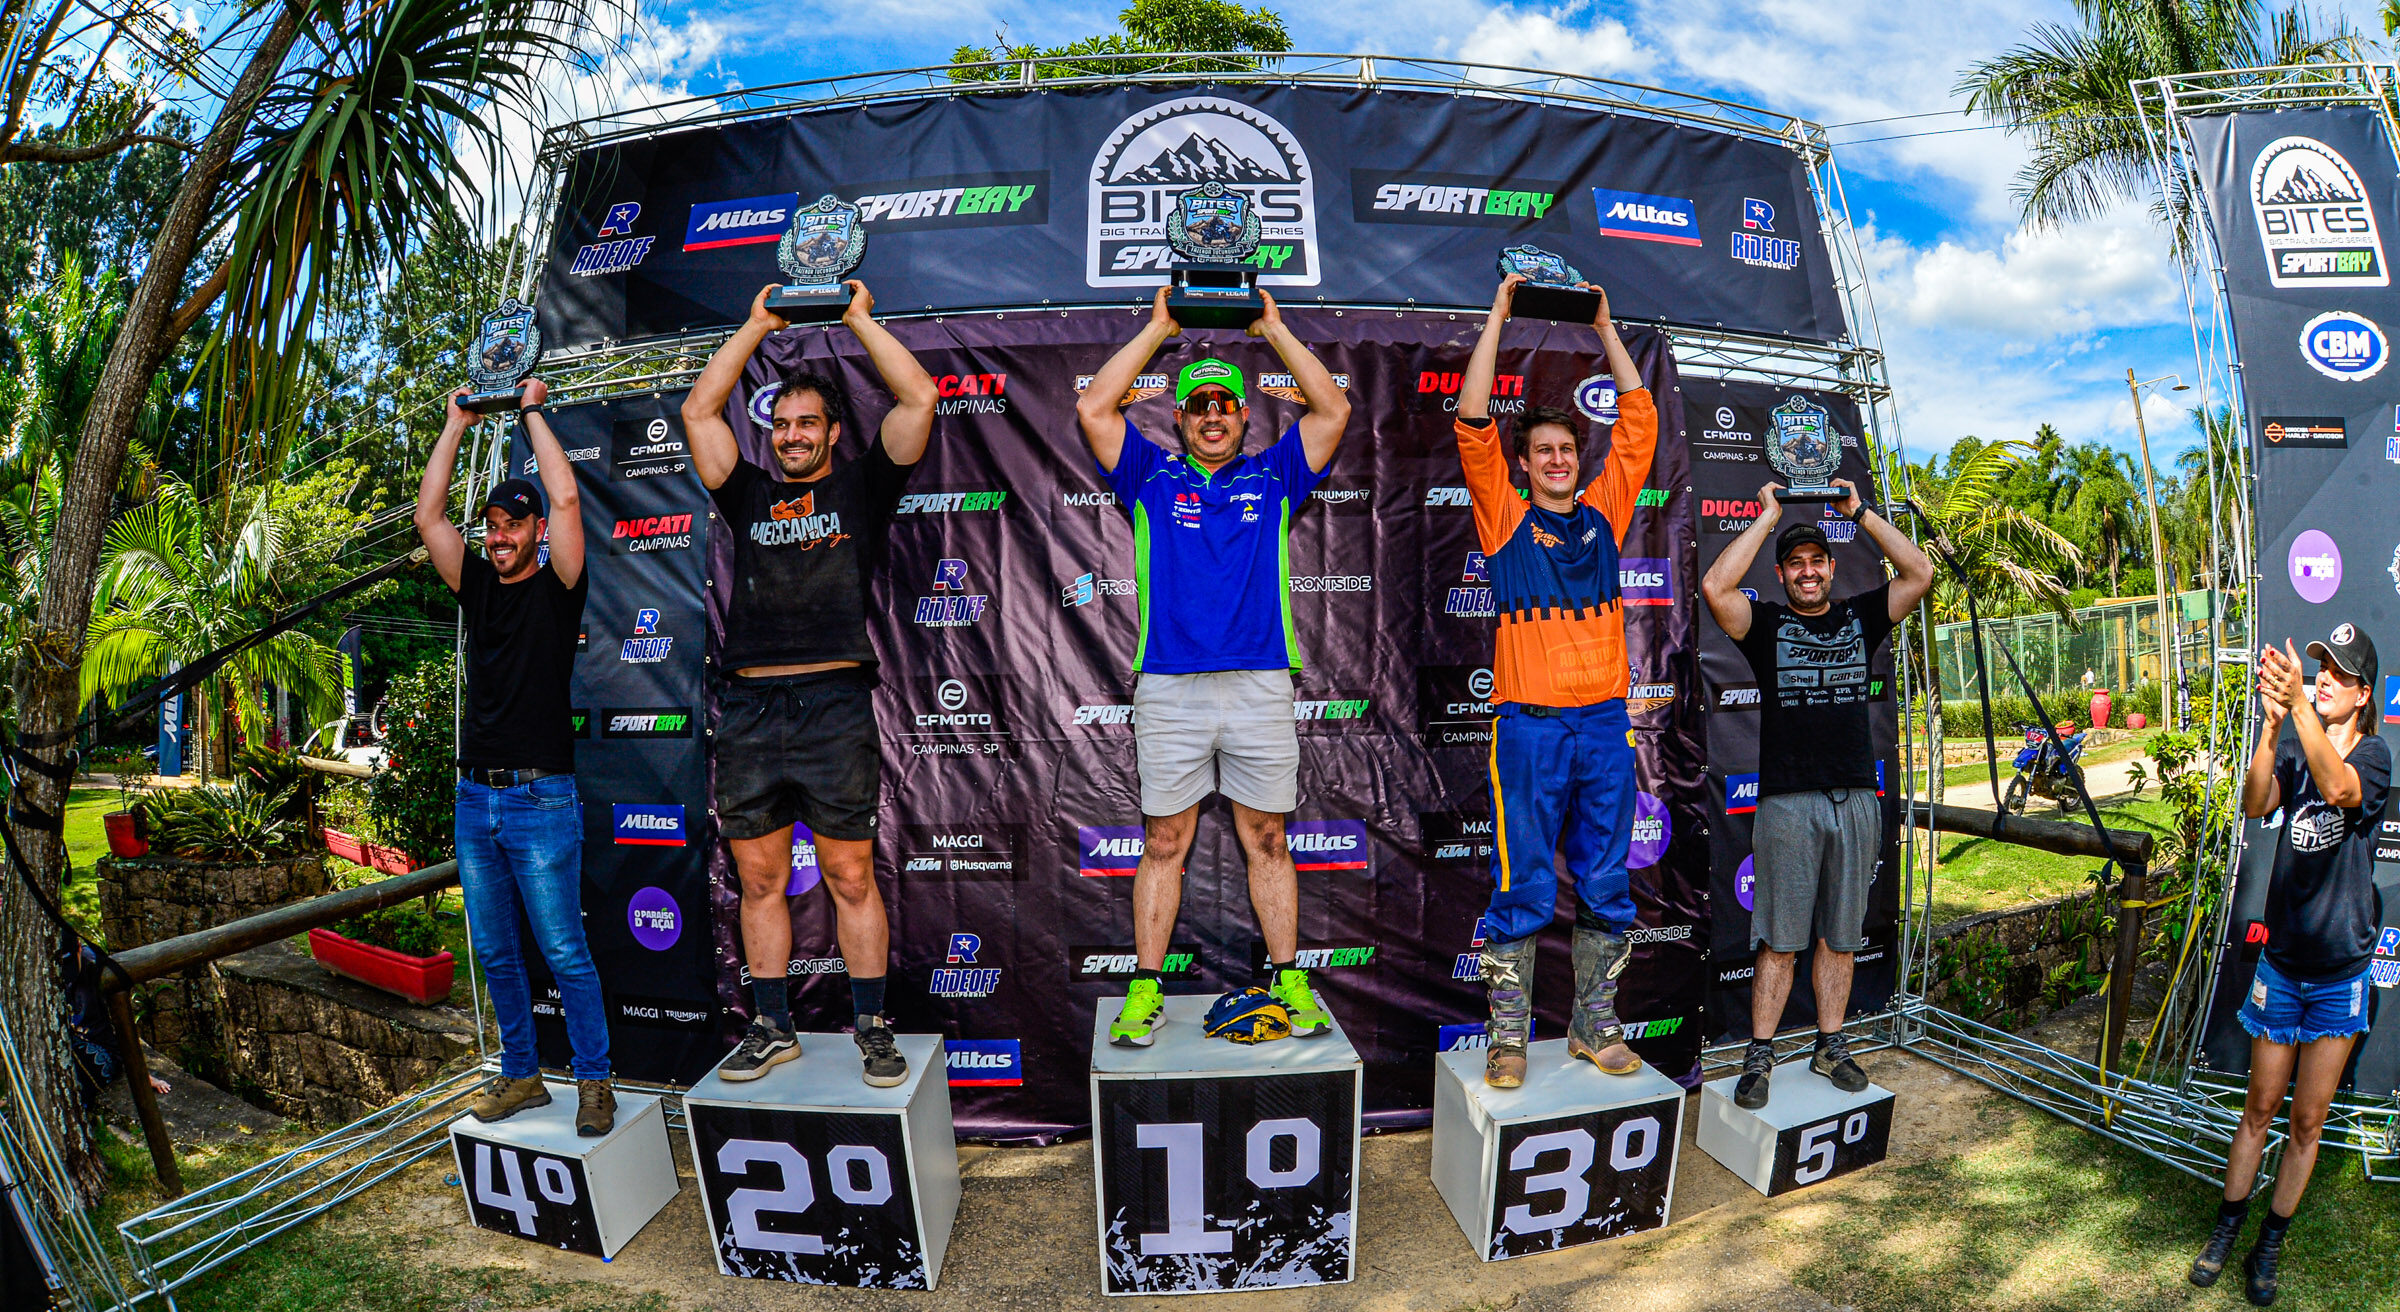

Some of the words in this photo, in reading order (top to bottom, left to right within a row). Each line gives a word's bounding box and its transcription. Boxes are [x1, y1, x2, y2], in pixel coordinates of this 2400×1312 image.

[853, 184, 1036, 223] SPORTBAY
[1191, 200, 1236, 210] BITES
[1373, 183, 1554, 219] SPORTBAY
[695, 207, 786, 233] Mitas
[804, 214, 847, 227] BITES
[1606, 200, 1690, 228] Mitas
[2262, 207, 2370, 235] BITES
[1100, 228, 1125, 236] BIG
[1129, 228, 1167, 236] TRAI
[1261, 228, 1304, 236] ERIES
[2269, 238, 2283, 246] BIG
[2310, 237, 2344, 245] ENDURO
[2346, 236, 2374, 244] SERIES
[1111, 245, 1293, 271] SPOAY
[2281, 251, 2372, 274] SPORTBAY
[580, 264, 632, 278] CALIFORNIA
[490, 317, 525, 334] BITES
[2314, 330, 2371, 358] CBM
[934, 373, 1007, 397] CATI
[1133, 375, 1167, 388] OTOS
[1418, 371, 1524, 397] DUTI
[1443, 397, 1525, 414] CAINAS
[1585, 387, 1618, 408] CB
[934, 398, 1006, 416] AMPINAS
[1781, 415, 1818, 427] BITES
[1703, 430, 1752, 441] CFMOTO
[564, 446, 601, 461] NTSIDE
[630, 441, 683, 456] CFMOTO
[1703, 451, 1743, 460] CAMPINAS
[1748, 453, 1758, 461] SP
[625, 464, 668, 478] CAMPINAS
[674, 463, 686, 473] SP
[897, 491, 1007, 514] SPORTBAY
[1063, 492, 1116, 506] MAGGI
[1311, 490, 1359, 504] TRIUMPH
[1702, 499, 1763, 518] DUCAT
[612, 514, 693, 539] DUCATI
[751, 512, 840, 546] MECCANICA
[628, 535, 691, 552] CAMPINAS
[801, 529, 852, 551] Gaage
[1620, 570, 1664, 587] itas
[925, 620, 972, 628] CALIFORNIA
[1559, 643, 1619, 669] ADVENTU
[1788, 641, 1860, 663] SPORTBAY
[1790, 675, 1813, 683] Shell
[1633, 684, 1674, 699] MOTOS
[1720, 688, 1761, 705] SPORT
[163, 660, 181, 743] Mits
[1293, 699, 1369, 720] RTBAY
[1447, 702, 1494, 715] CFMO
[609, 715, 687, 731] SPORTBAY
[915, 713, 991, 726] CFMOTO
[1072, 704, 1136, 725] SPORT
[1443, 731, 1494, 743] CAMPINA
[912, 744, 974, 755] CAMPINAS
[983, 743, 999, 754] SP
[620, 814, 679, 831] Mitas
[1462, 821, 1493, 834] MAG
[932, 834, 983, 848] MAGGI
[2291, 819, 2345, 848] BITES
[1435, 844, 1470, 858] KTM
[905, 857, 942, 871] KTM
[959, 860, 1012, 872] Husqvarna
[1623, 925, 1692, 945] RONTSIDE
[787, 958, 848, 975] ONTSID
[1081, 953, 1193, 974] SPORAY
[1263, 947, 1375, 970] ORTBAY
[1719, 966, 1754, 982] MAGGI
[623, 1005, 659, 1019] MAGGI
[665, 1009, 699, 1022] TRIUMPH
[1622, 1016, 1683, 1041] RTBAY
